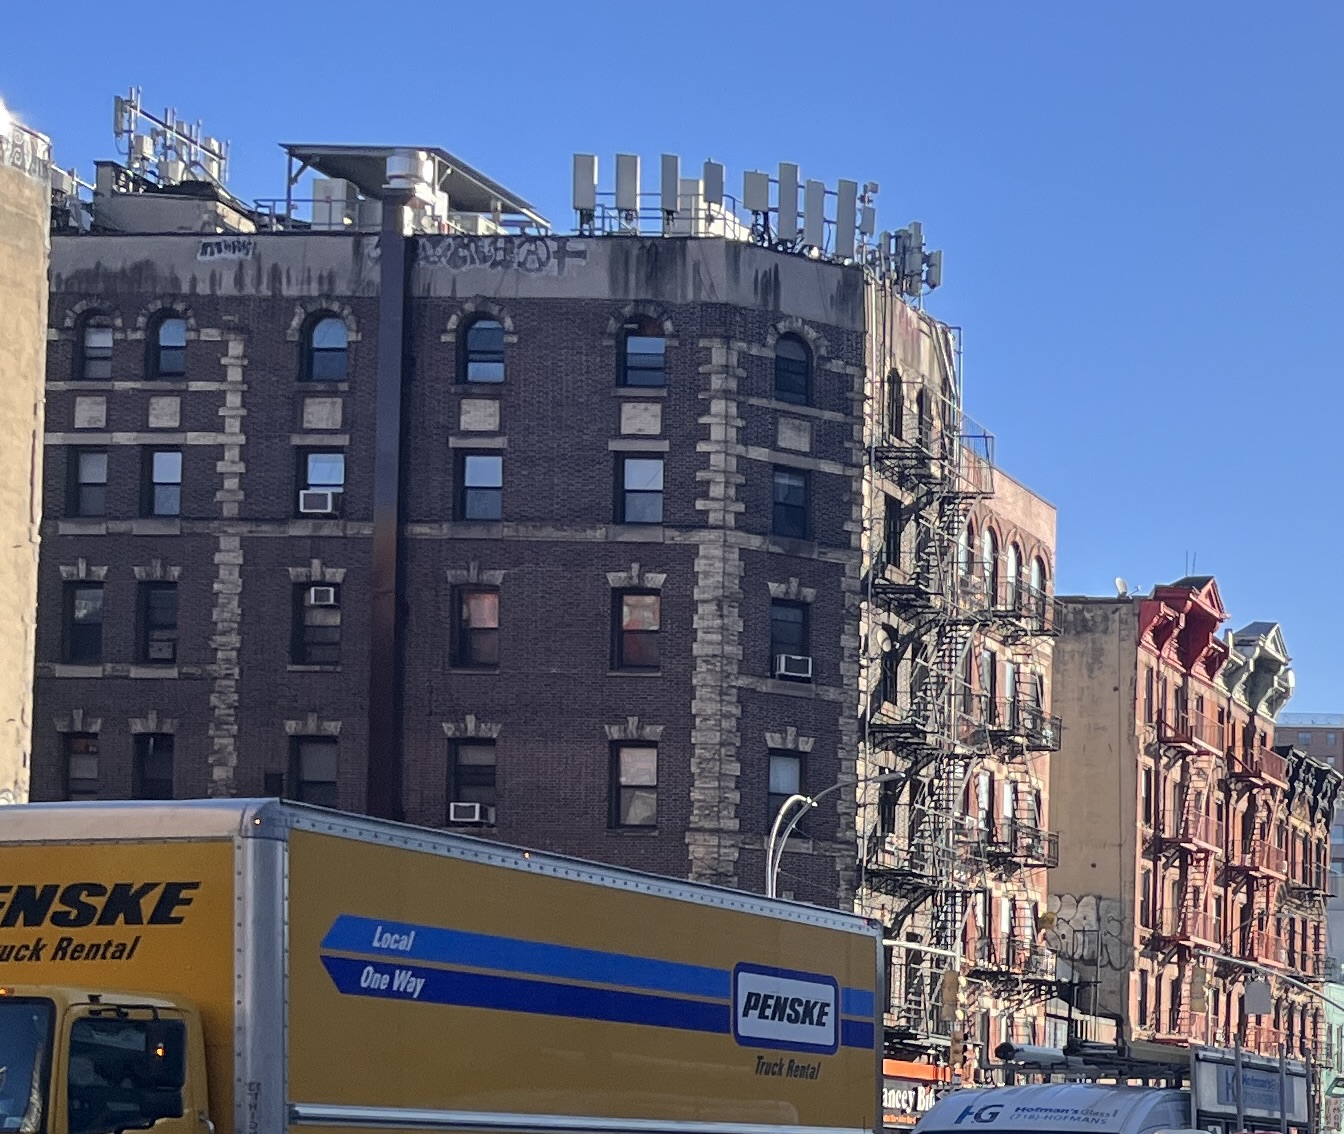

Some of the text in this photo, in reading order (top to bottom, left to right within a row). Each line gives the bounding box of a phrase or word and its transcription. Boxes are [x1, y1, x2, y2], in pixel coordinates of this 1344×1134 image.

[0, 936, 142, 962] uck Rental
[372, 925, 416, 951] Local
[360, 965, 426, 998] One Way
[742, 991, 831, 1028] PENSKE
[755, 1055, 822, 1080] Truck Rental
[882, 1087, 916, 1114] ancey
[1014, 1106, 1079, 1115] Hofman's
